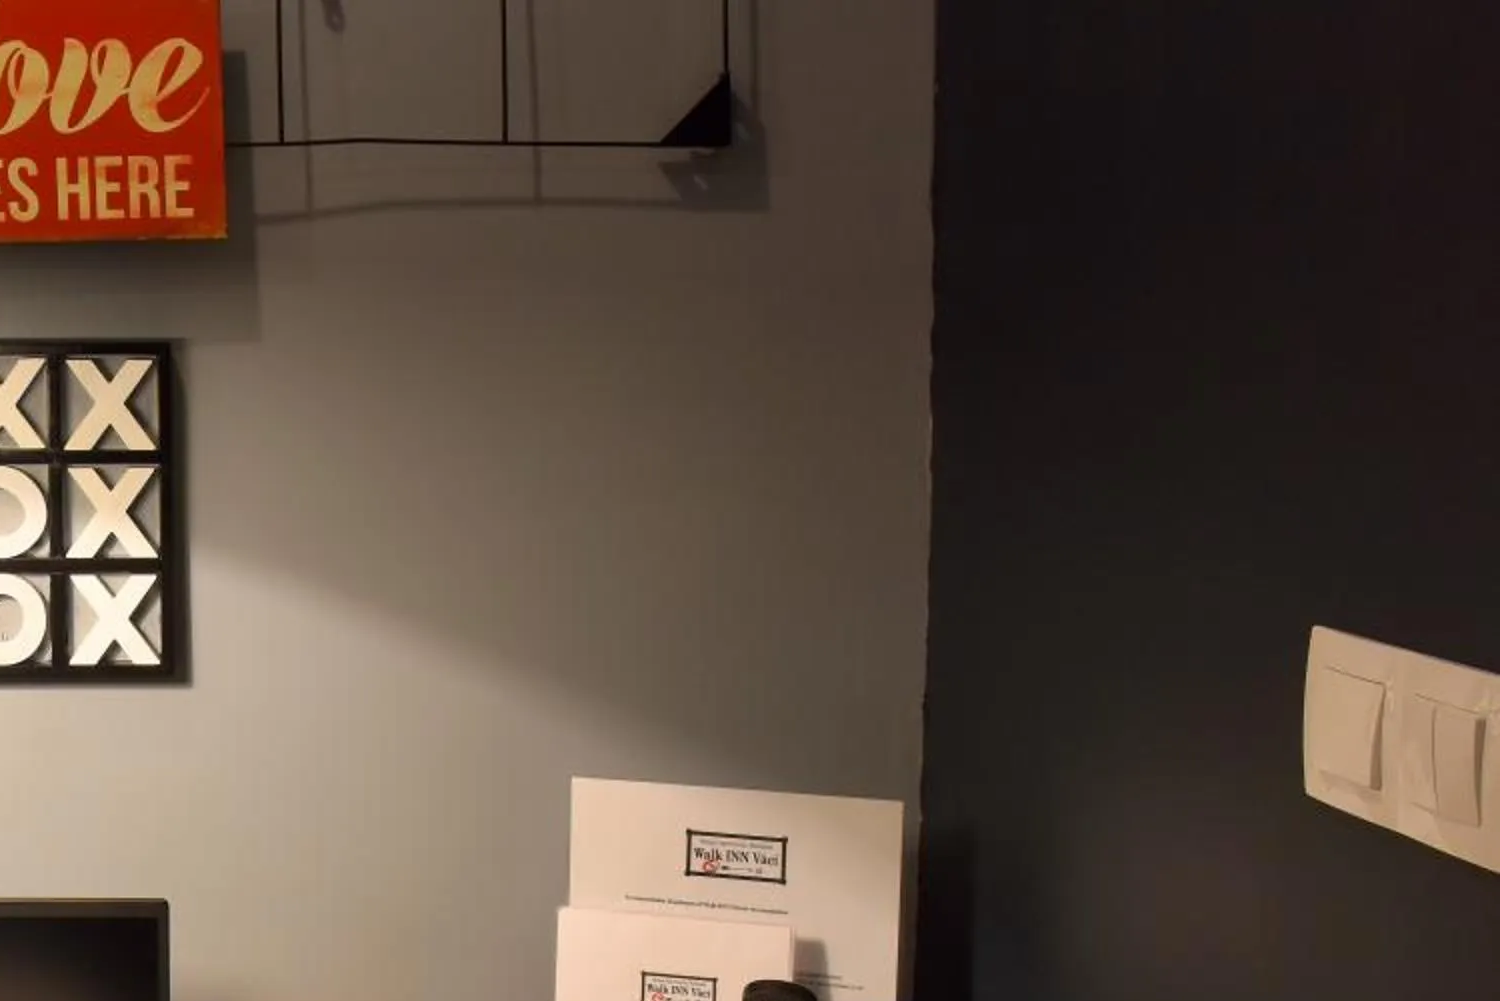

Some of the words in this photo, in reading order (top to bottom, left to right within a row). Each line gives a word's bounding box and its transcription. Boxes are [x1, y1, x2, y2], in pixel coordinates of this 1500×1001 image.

[56, 155, 195, 220] HERE
[694, 847, 722, 862] Walk
[726, 849, 749, 863] INN
